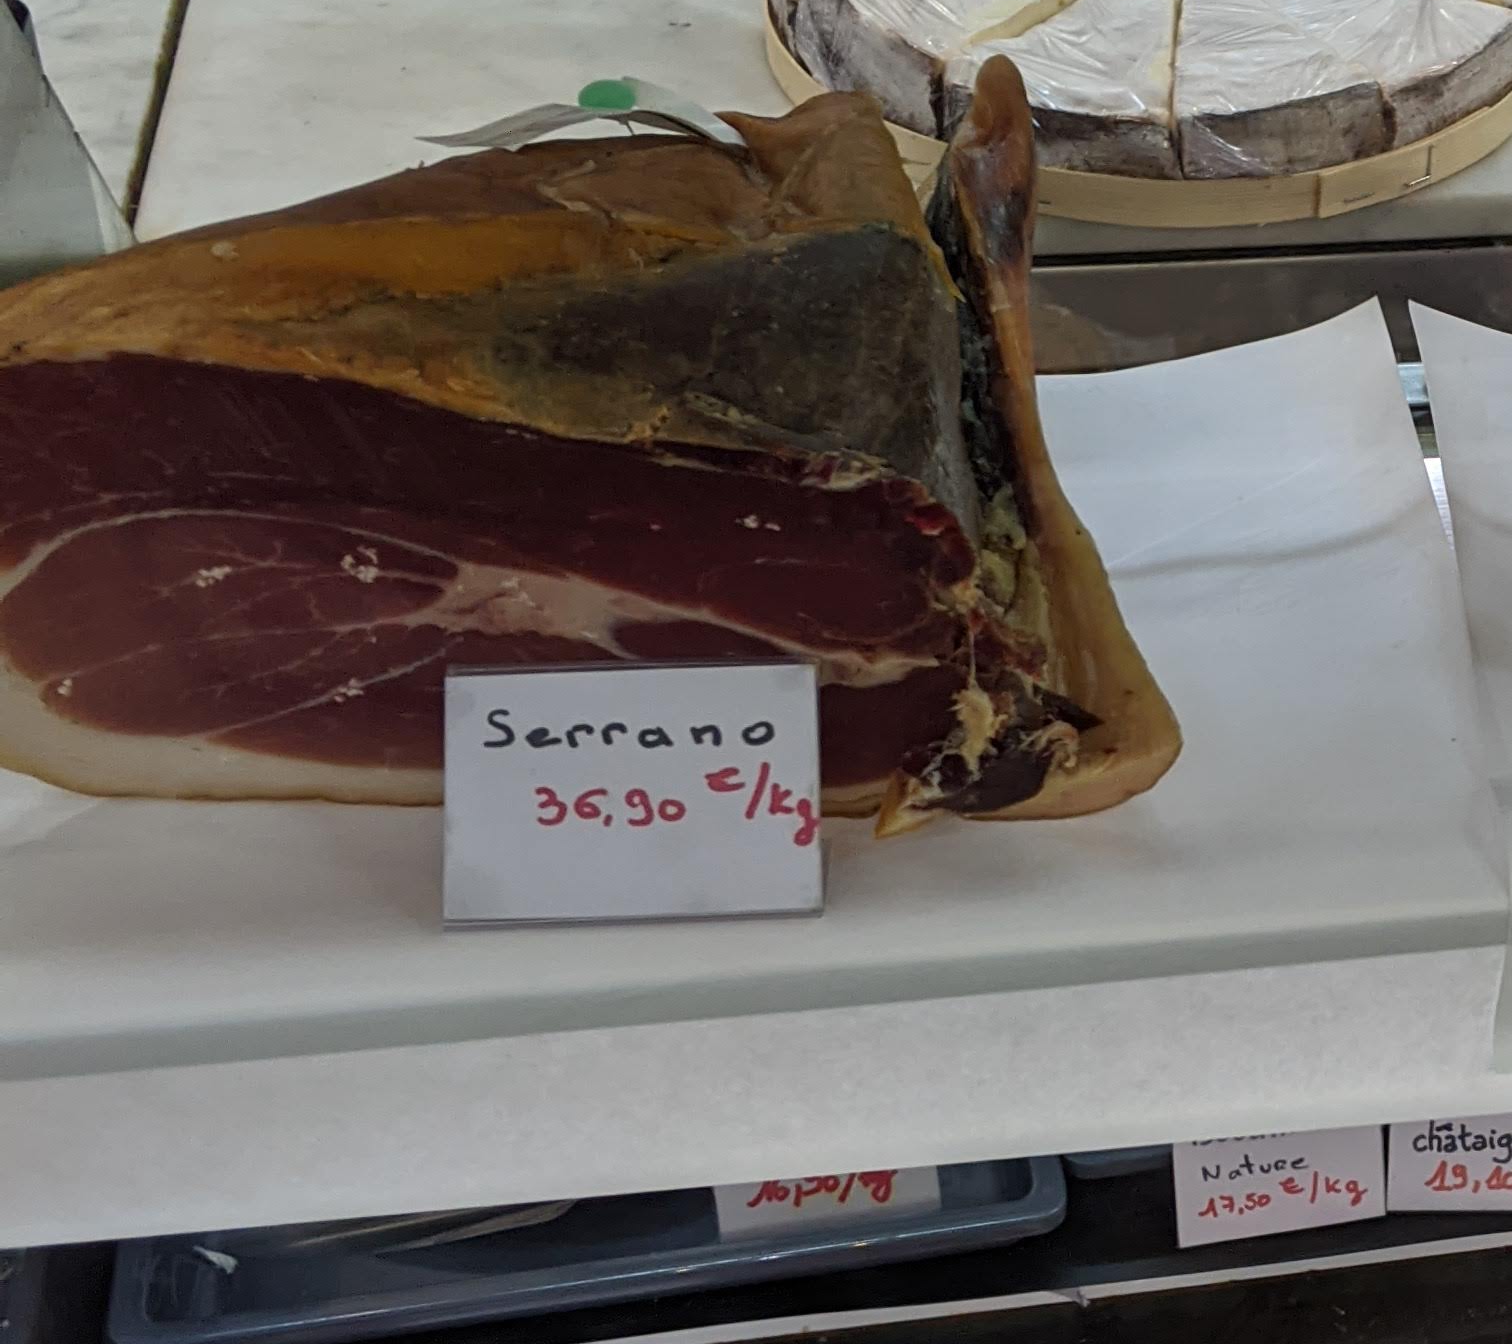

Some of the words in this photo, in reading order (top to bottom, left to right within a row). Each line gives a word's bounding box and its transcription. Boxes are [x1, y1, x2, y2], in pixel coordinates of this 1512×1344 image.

[483, 708, 777, 750] Serrano
[534, 786, 687, 829] 36,90
[1201, 1153, 1311, 1183] Nature
[1197, 1192, 1273, 1219] 17,50
